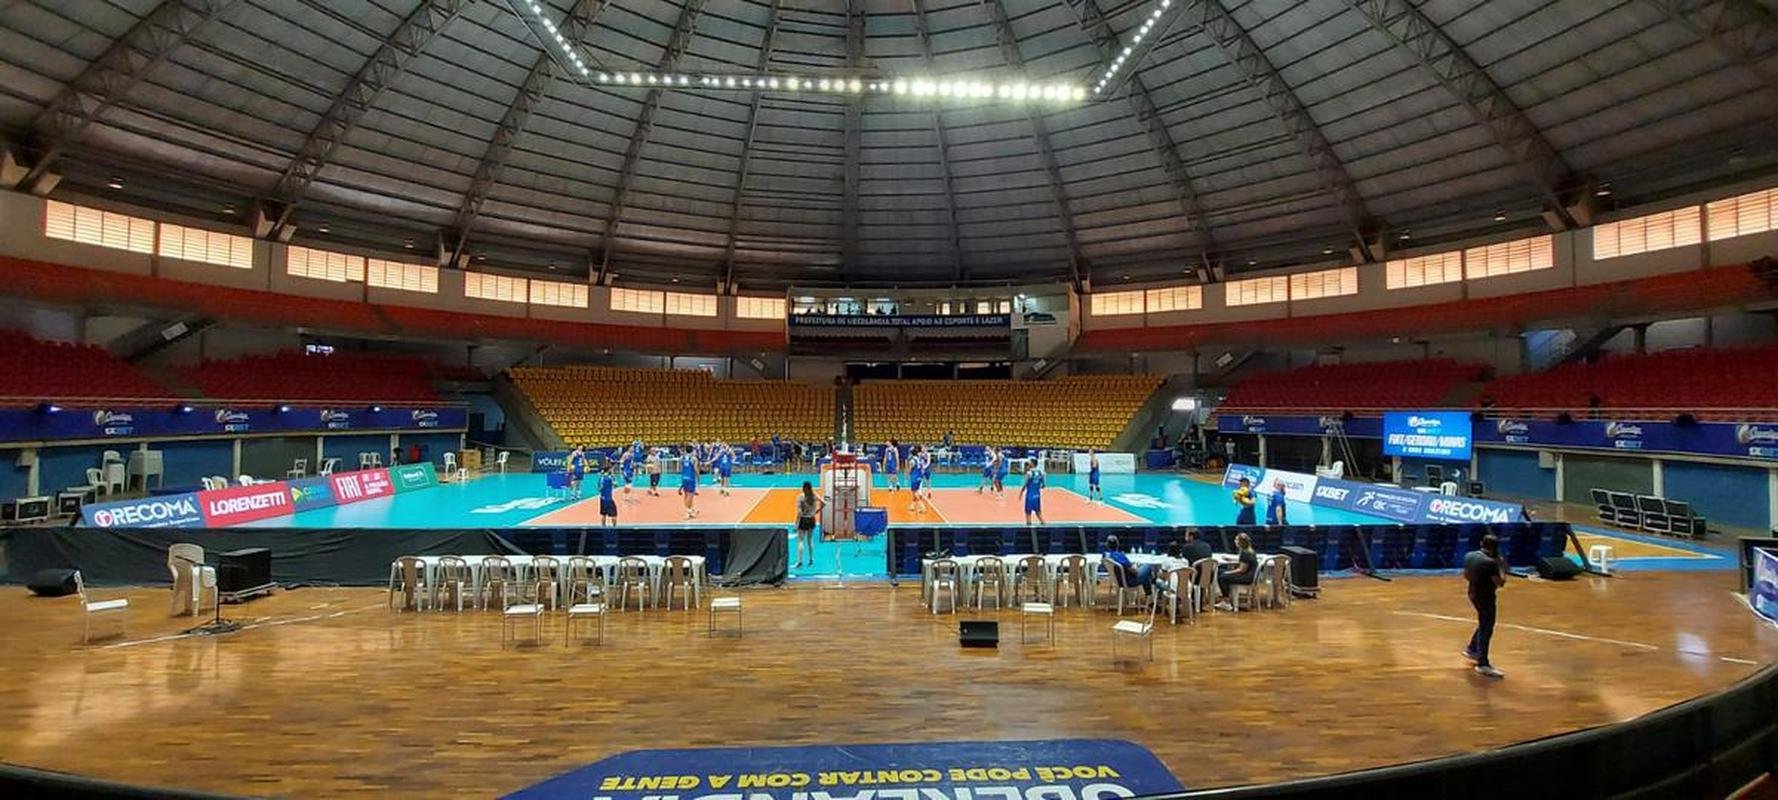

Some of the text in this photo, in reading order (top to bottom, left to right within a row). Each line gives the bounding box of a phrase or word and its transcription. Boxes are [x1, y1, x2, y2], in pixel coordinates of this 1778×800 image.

[336, 474, 362, 500] FIAT
[111, 498, 198, 526] RECOMA
[210, 491, 287, 517] LORENZETTI
[1441, 500, 1510, 524] RECOMA
[599, 765, 1120, 791] VOCÊ PODE CONTAR COM A GENTE
